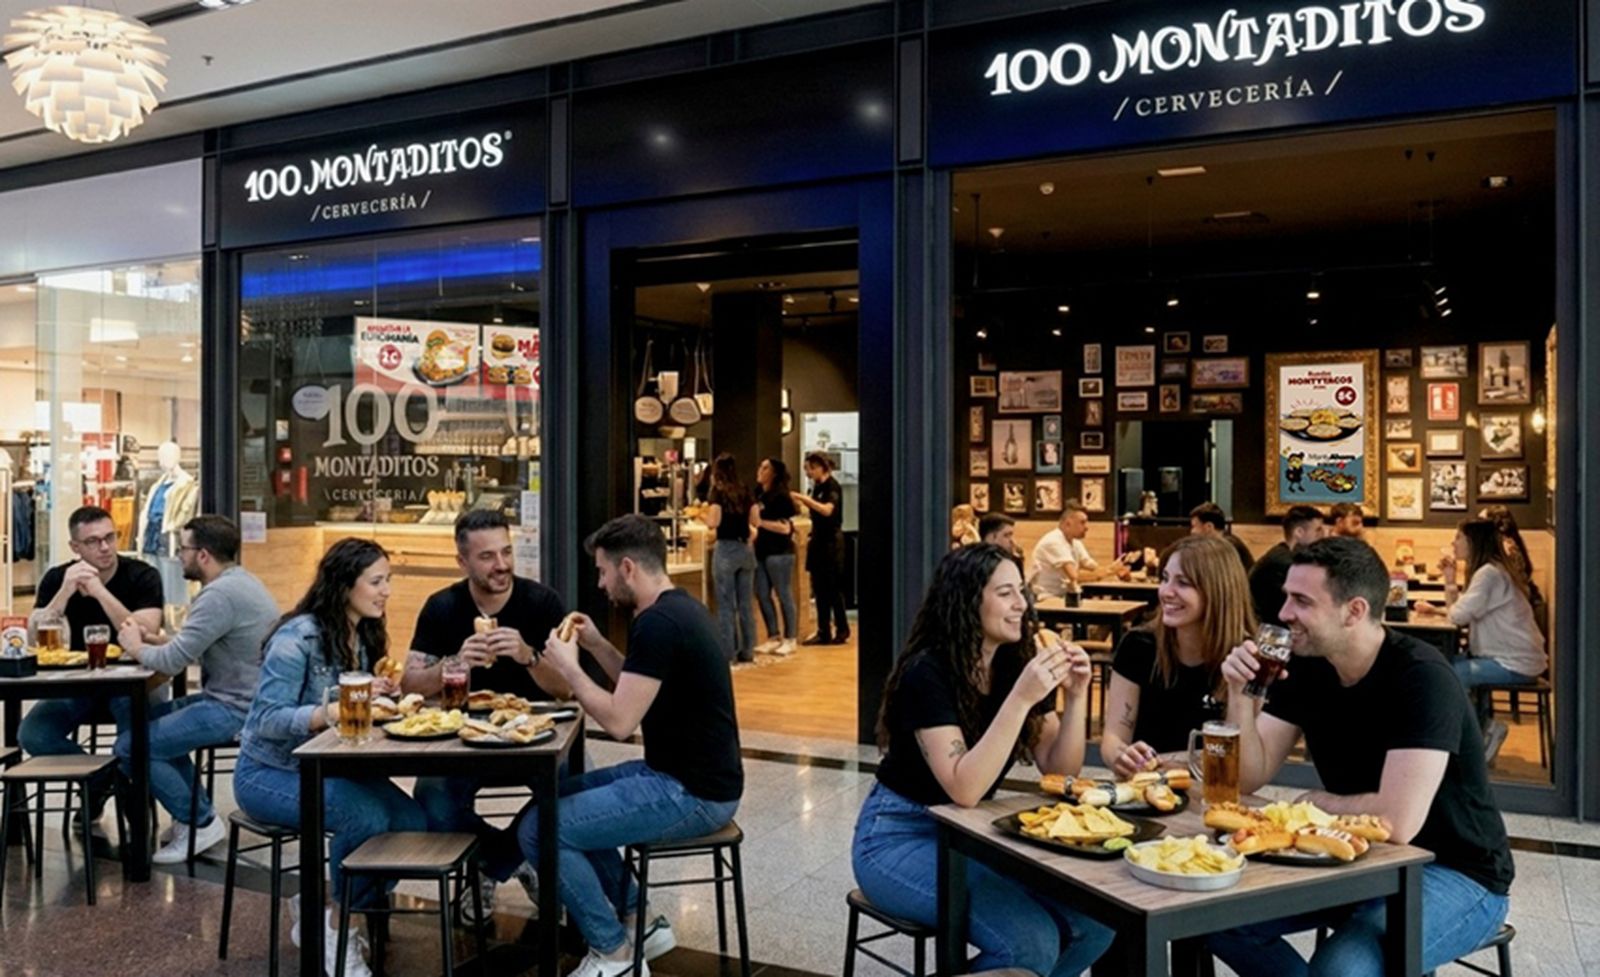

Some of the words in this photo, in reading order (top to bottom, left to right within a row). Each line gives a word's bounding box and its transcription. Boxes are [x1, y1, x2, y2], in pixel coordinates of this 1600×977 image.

[985, 43, 1092, 96] 100
[1099, 0, 1487, 83] MONTADITOS
[244, 165, 301, 202] 100
[303, 132, 504, 195] MONTADITOS
[323, 383, 441, 448] 100
[314, 455, 440, 478] MONTADITOS
